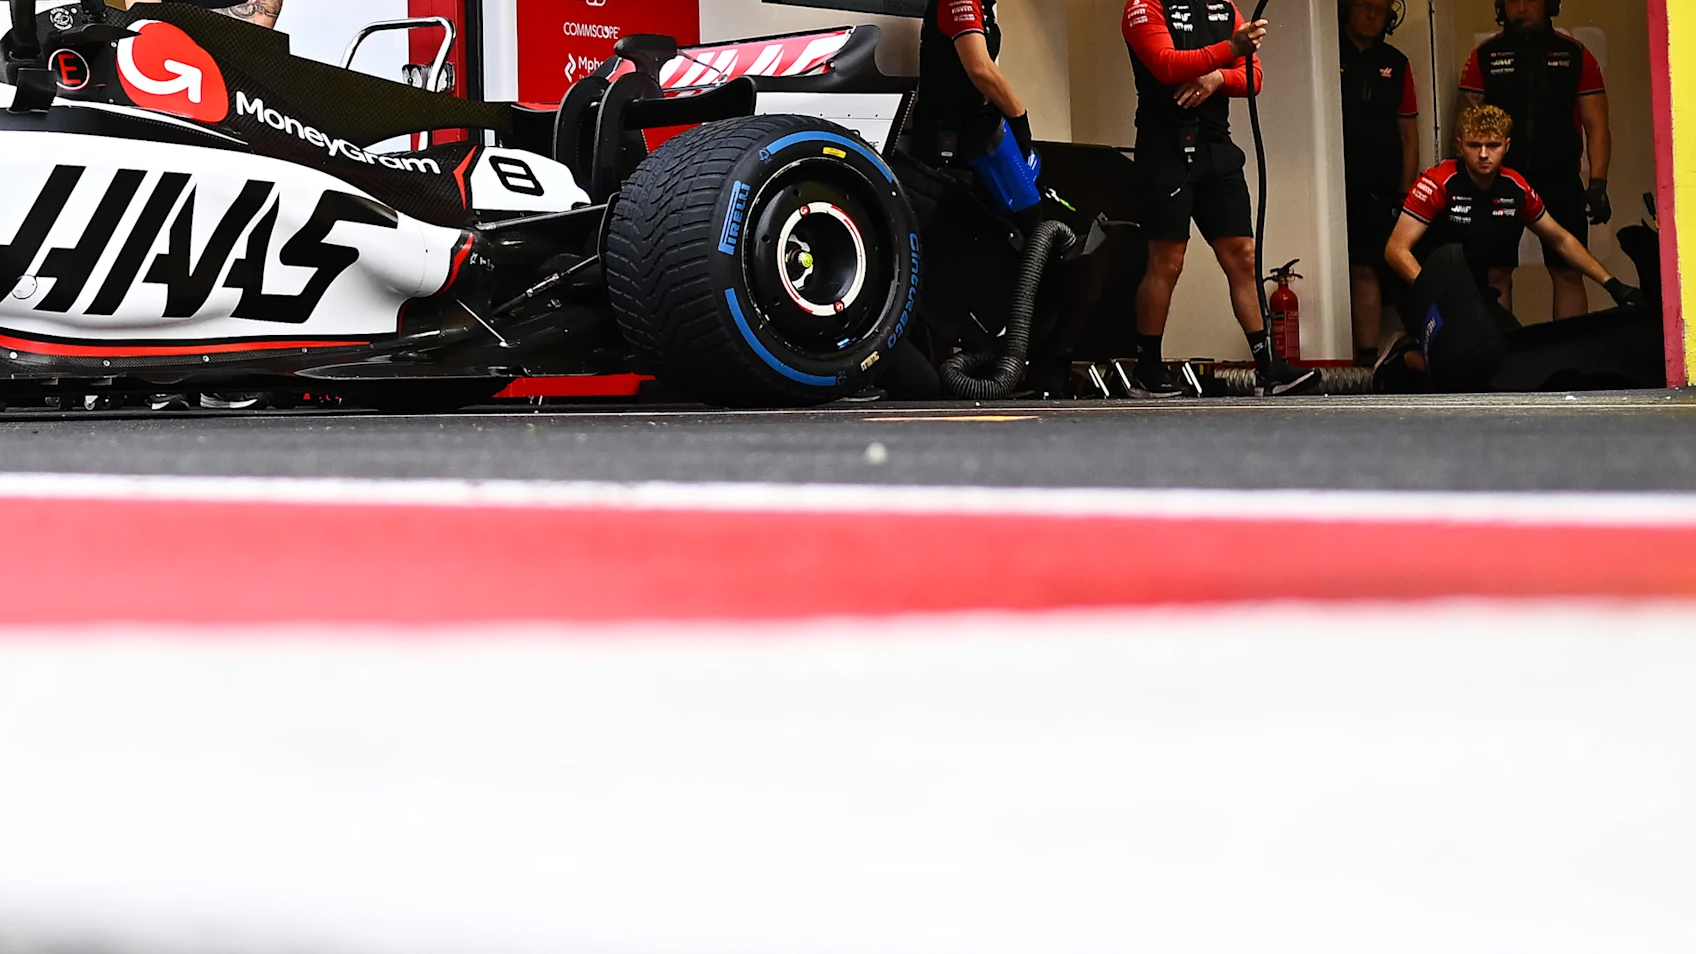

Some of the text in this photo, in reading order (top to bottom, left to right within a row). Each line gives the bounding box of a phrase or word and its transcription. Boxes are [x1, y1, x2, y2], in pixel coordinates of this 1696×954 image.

[58, 53, 81, 84] E
[236, 91, 440, 175] MoneyGram
[489, 155, 544, 197] 8
[717, 180, 751, 255] PIRELLI
[887, 232, 920, 349] Cinturato
